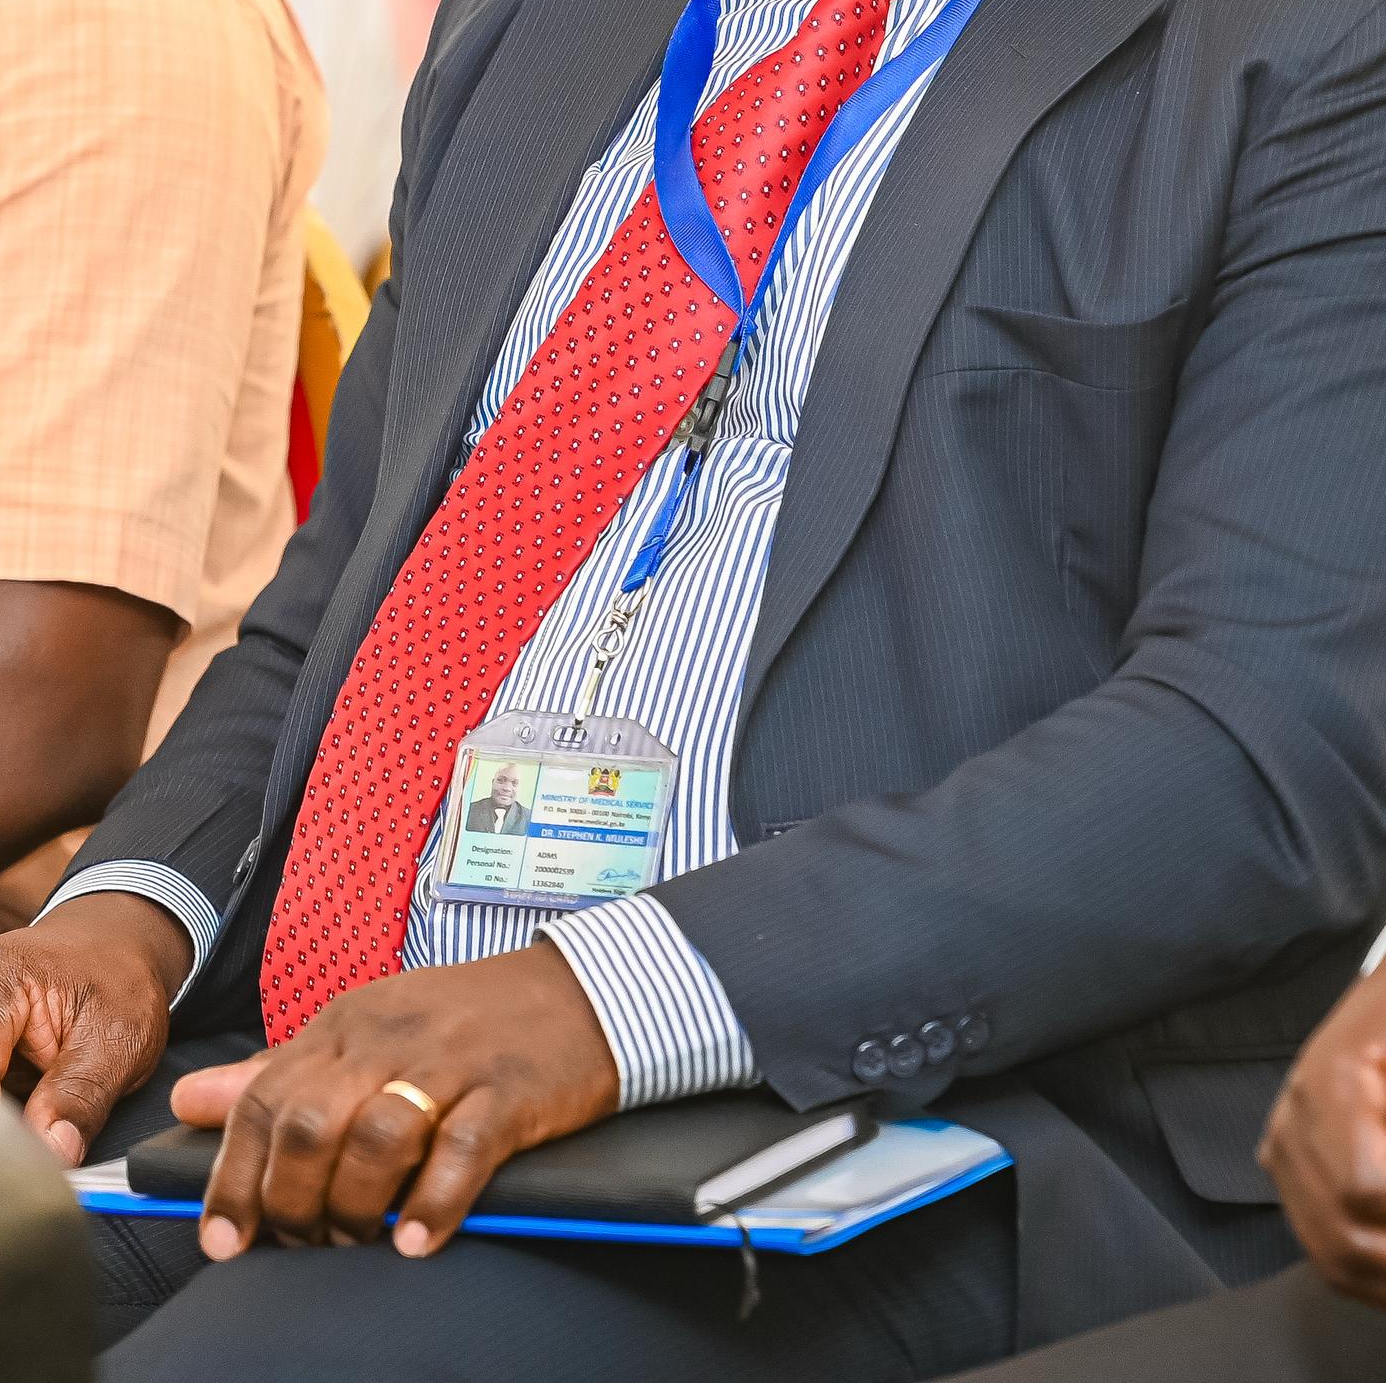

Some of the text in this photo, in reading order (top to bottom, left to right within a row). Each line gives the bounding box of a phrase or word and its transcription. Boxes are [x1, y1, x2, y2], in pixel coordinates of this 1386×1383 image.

[541, 794, 575, 803] MINISTRY
[591, 798, 623, 807] MEDICAL
[541, 828, 555, 838] DR.
[558, 830, 594, 841] STEPHEN
[471, 845, 513, 855] Designation:
[466, 859, 495, 868] Personal
